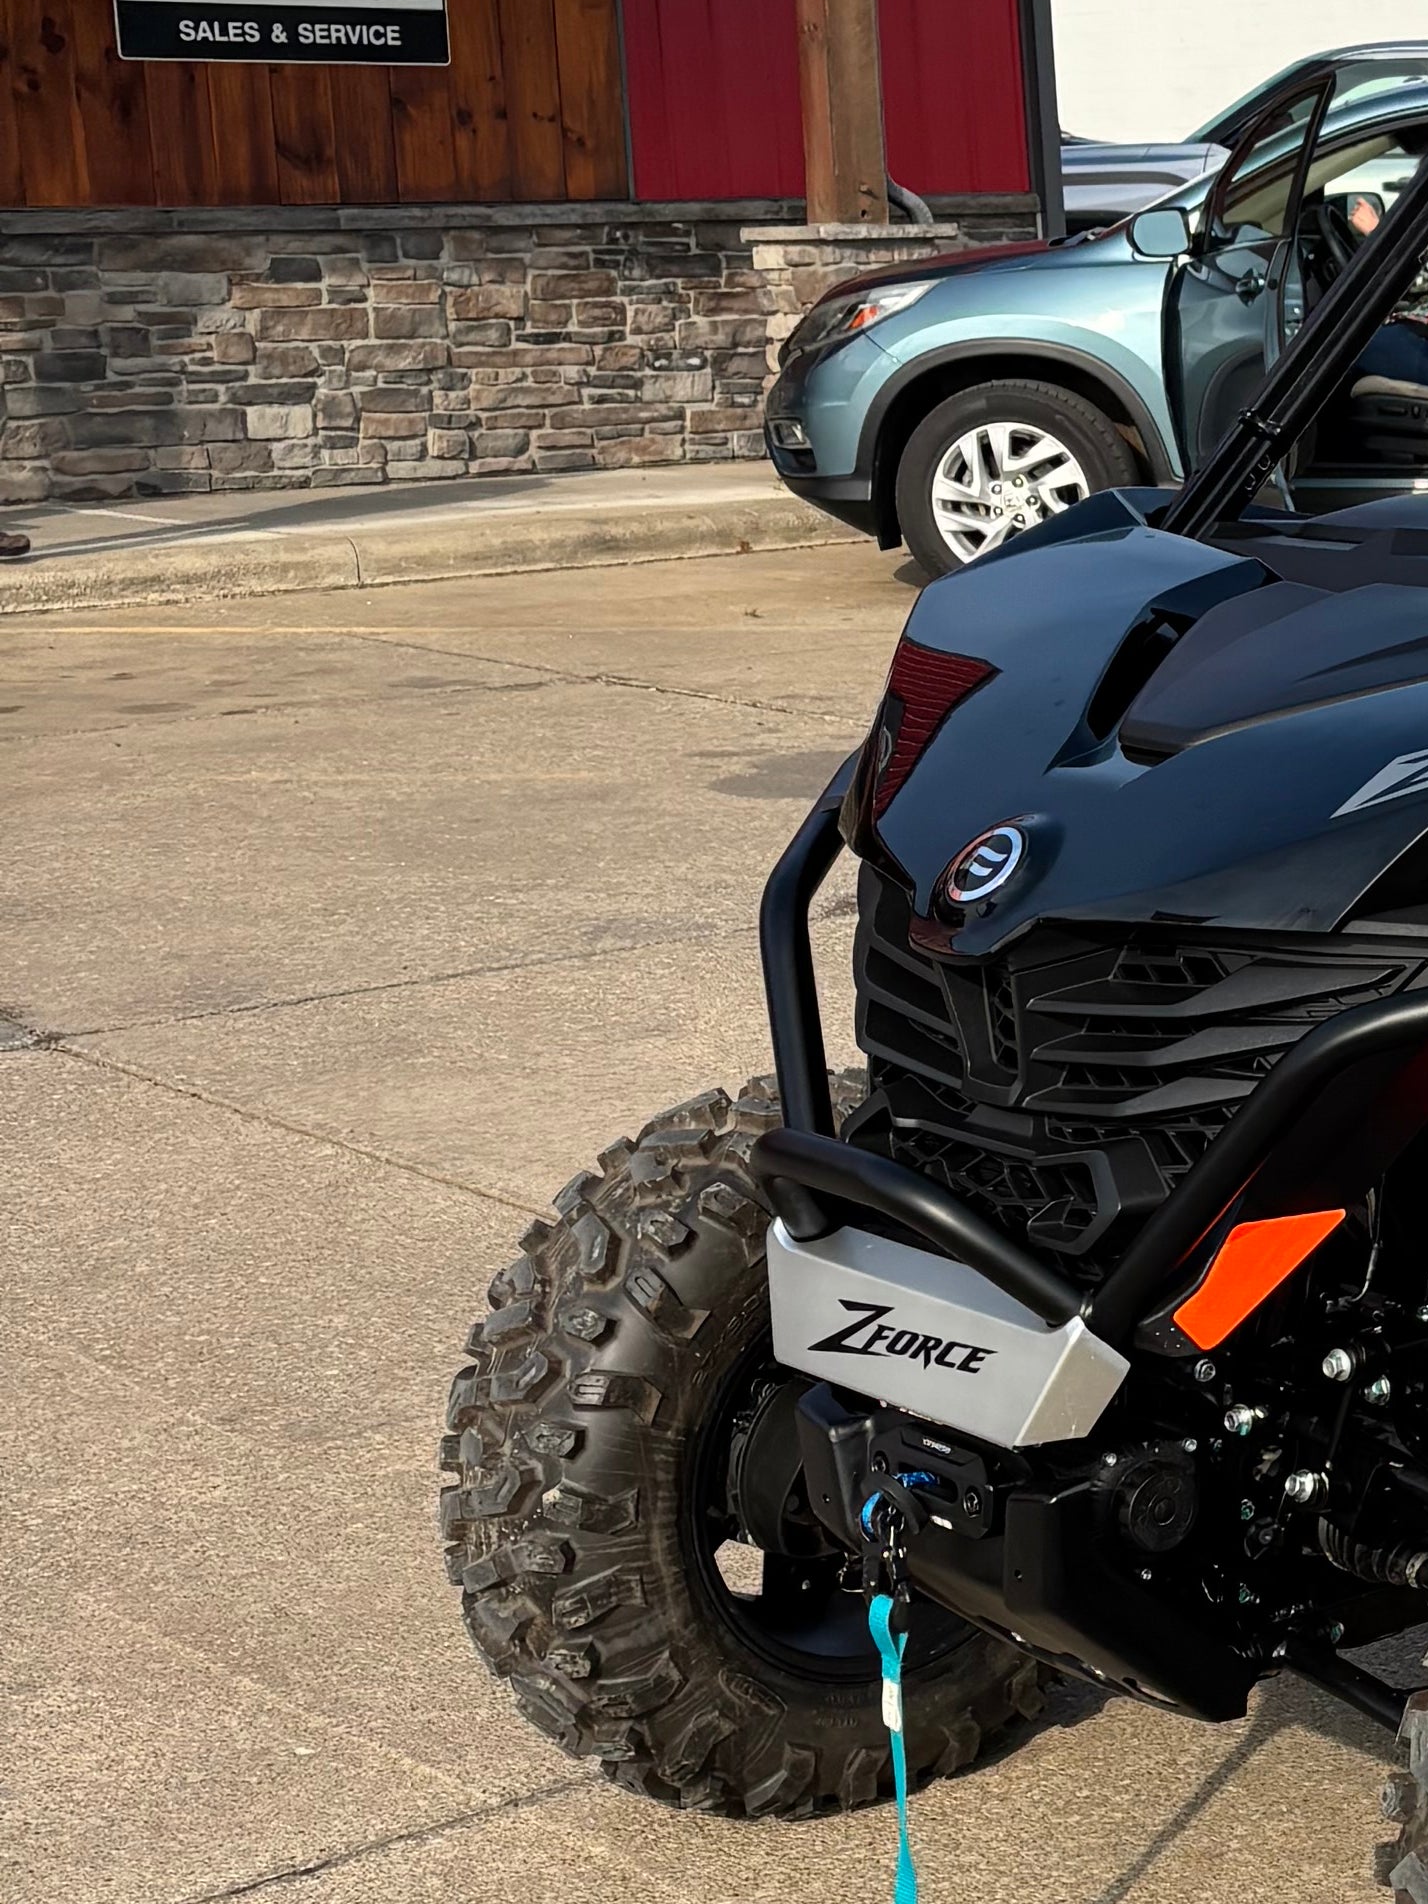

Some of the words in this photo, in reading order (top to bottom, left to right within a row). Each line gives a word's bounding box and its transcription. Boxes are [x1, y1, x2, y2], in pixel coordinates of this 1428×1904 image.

[179, 20, 261, 43] SALES
[270, 23, 289, 44] &
[298, 24, 402, 46] SERVICE
[807, 1298, 999, 1374] ZFORCE
